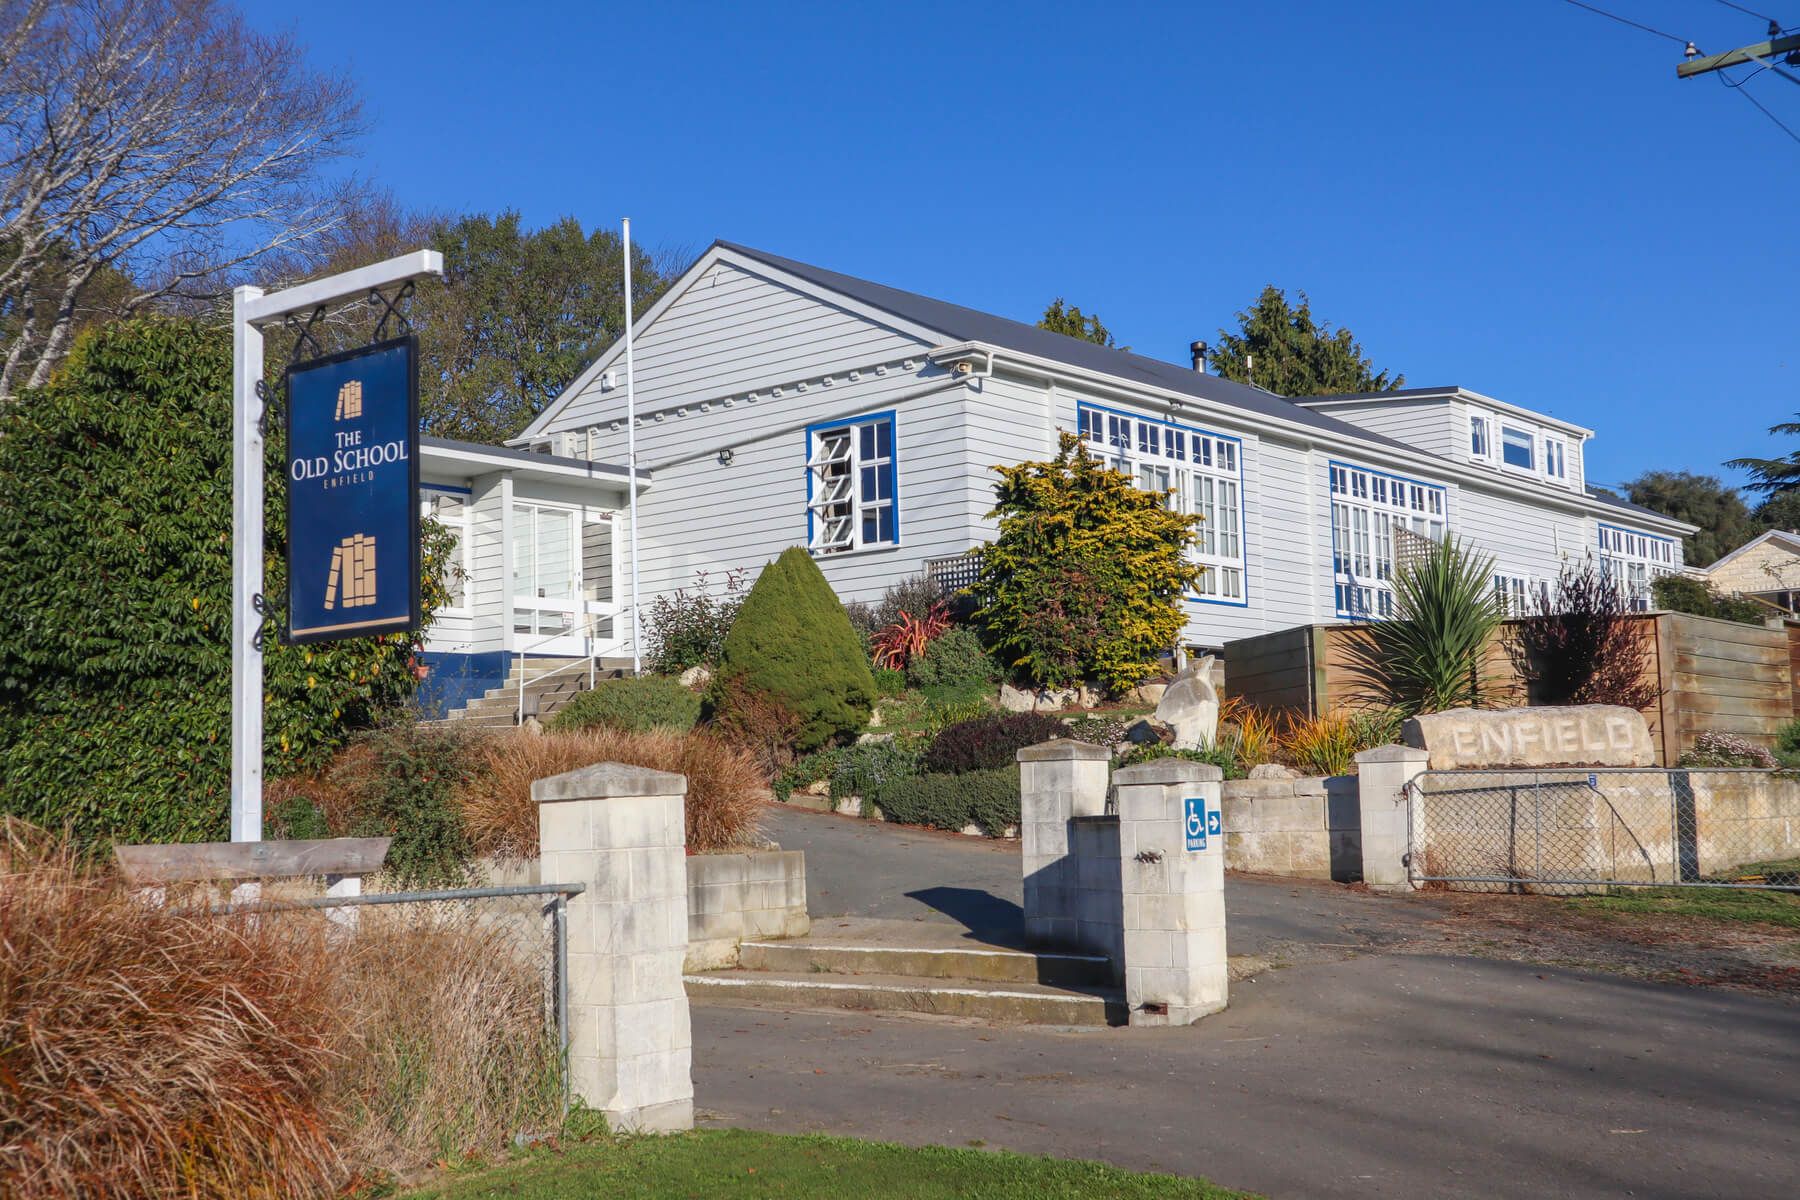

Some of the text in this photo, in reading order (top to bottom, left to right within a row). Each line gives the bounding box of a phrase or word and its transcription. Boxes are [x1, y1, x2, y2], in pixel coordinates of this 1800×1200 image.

[335, 430, 362, 449] THE
[291, 440, 409, 481] OLD SCHOOL
[323, 470, 374, 490] ENFIELD
[1452, 715, 1633, 757] ENFIELD
[1187, 838, 1206, 849] PARKING
